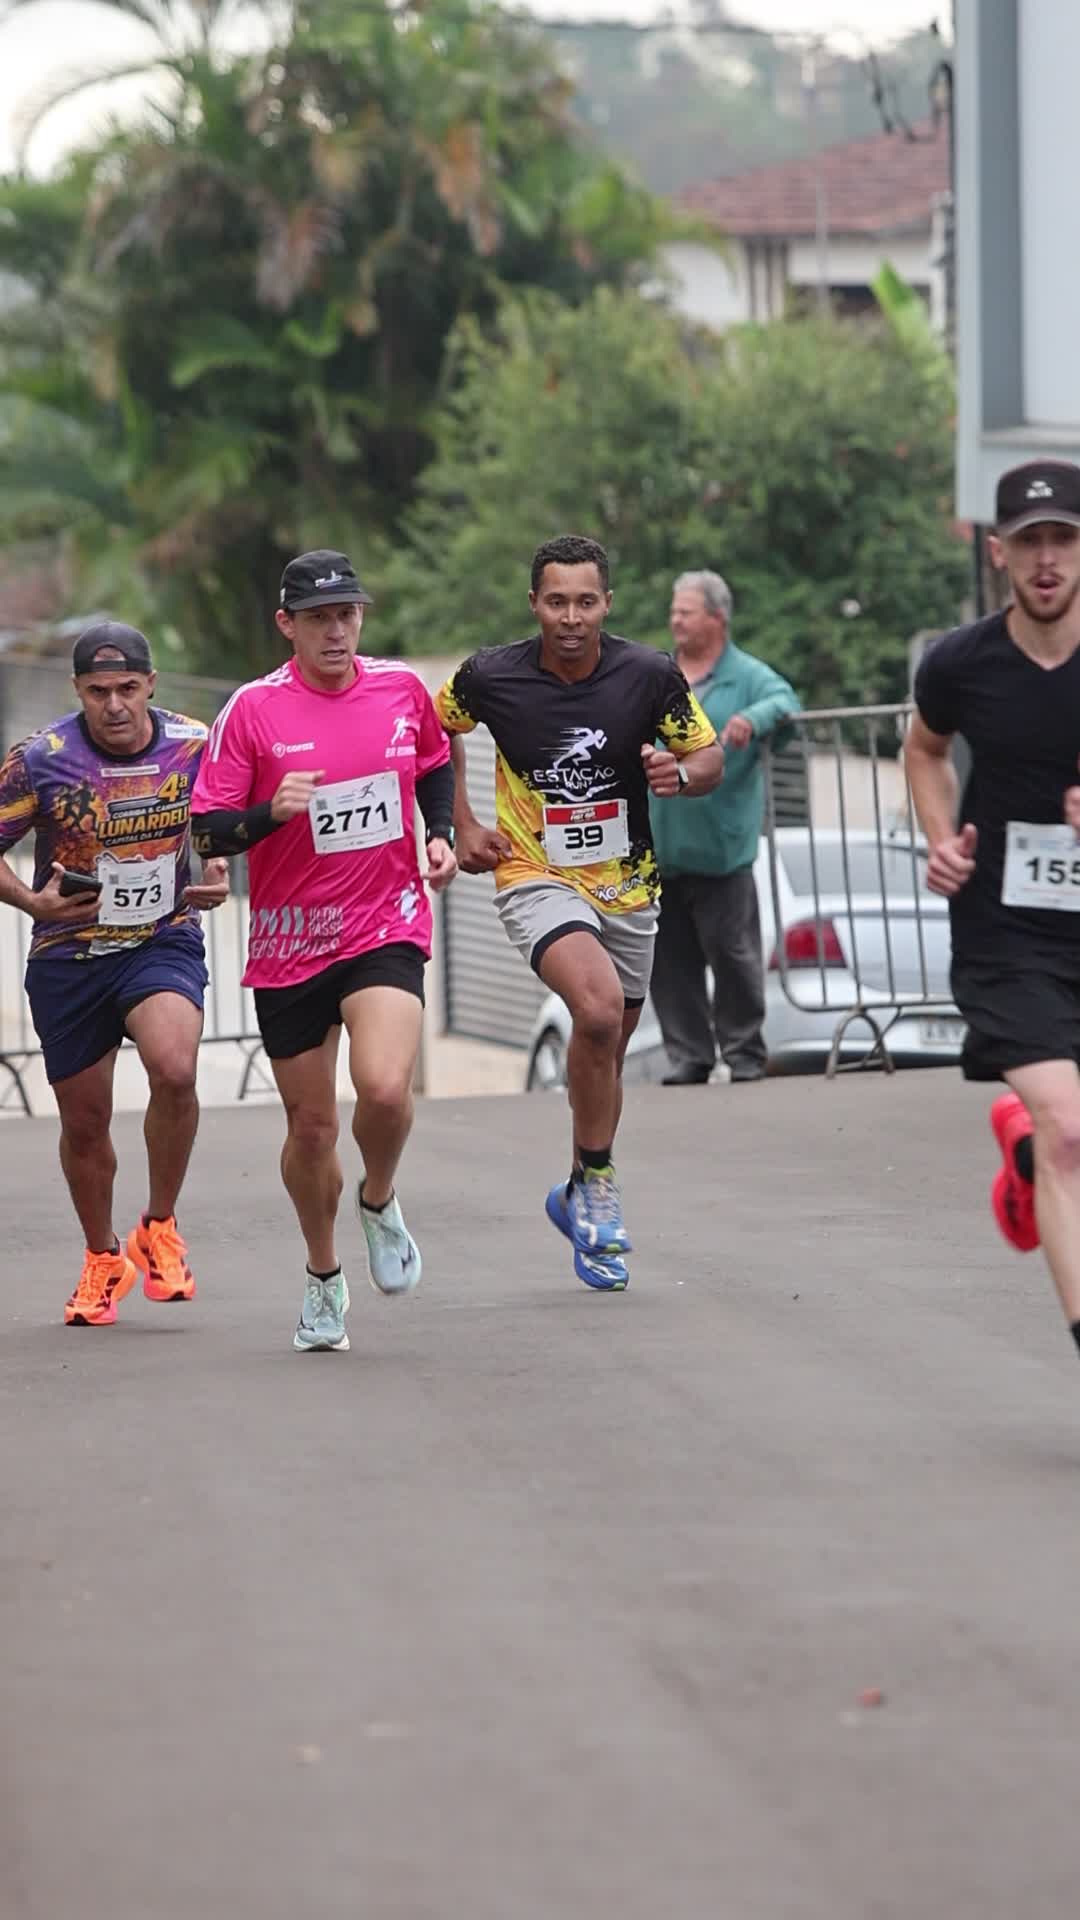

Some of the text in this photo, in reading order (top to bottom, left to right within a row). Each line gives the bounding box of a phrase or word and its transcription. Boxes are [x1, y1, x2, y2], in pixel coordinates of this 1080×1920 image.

[533, 765, 615, 785] ESTAÇÃO
[317, 801, 389, 835] 2771
[564, 825, 604, 849] 39
[113, 884, 161, 907] 573
